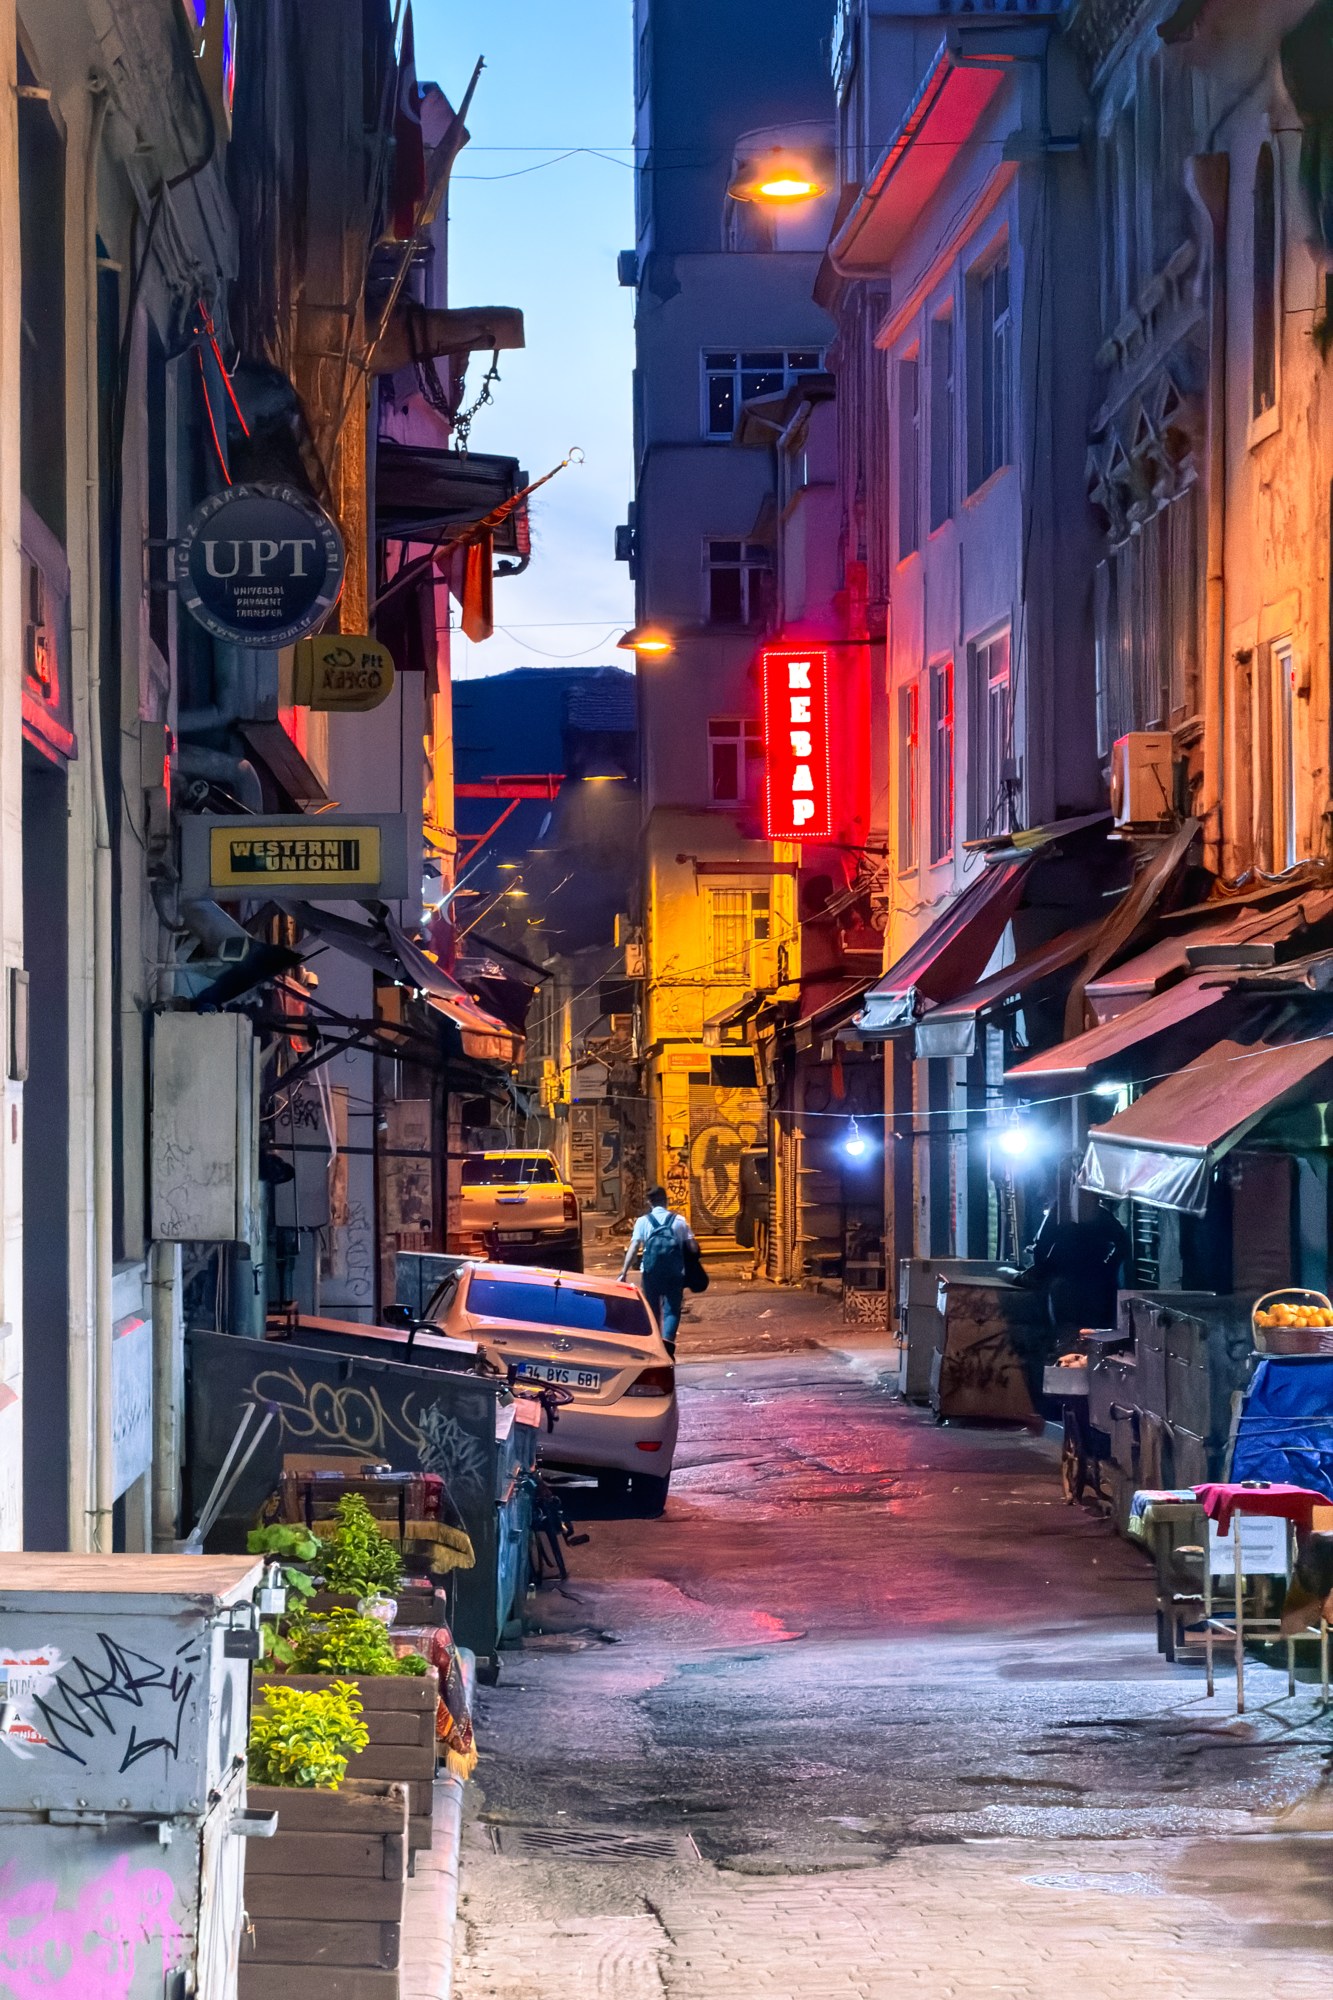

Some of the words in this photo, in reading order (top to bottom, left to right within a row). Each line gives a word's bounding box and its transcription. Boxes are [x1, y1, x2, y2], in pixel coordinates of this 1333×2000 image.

[201, 486, 249, 517] PARA
[201, 539, 316, 578] UPT
[233, 586, 284, 596] UNIVERSAL
[237, 598, 281, 606] PAYMENT
[236, 608, 283, 618] TRANSFER
[206, 616, 311, 643] www.upt.com.tr
[788, 661, 815, 826] KEBAP
[232, 841, 339, 857] WESTERN
[265, 855, 339, 871] UNION
[546, 1368, 570, 1384] BYS
